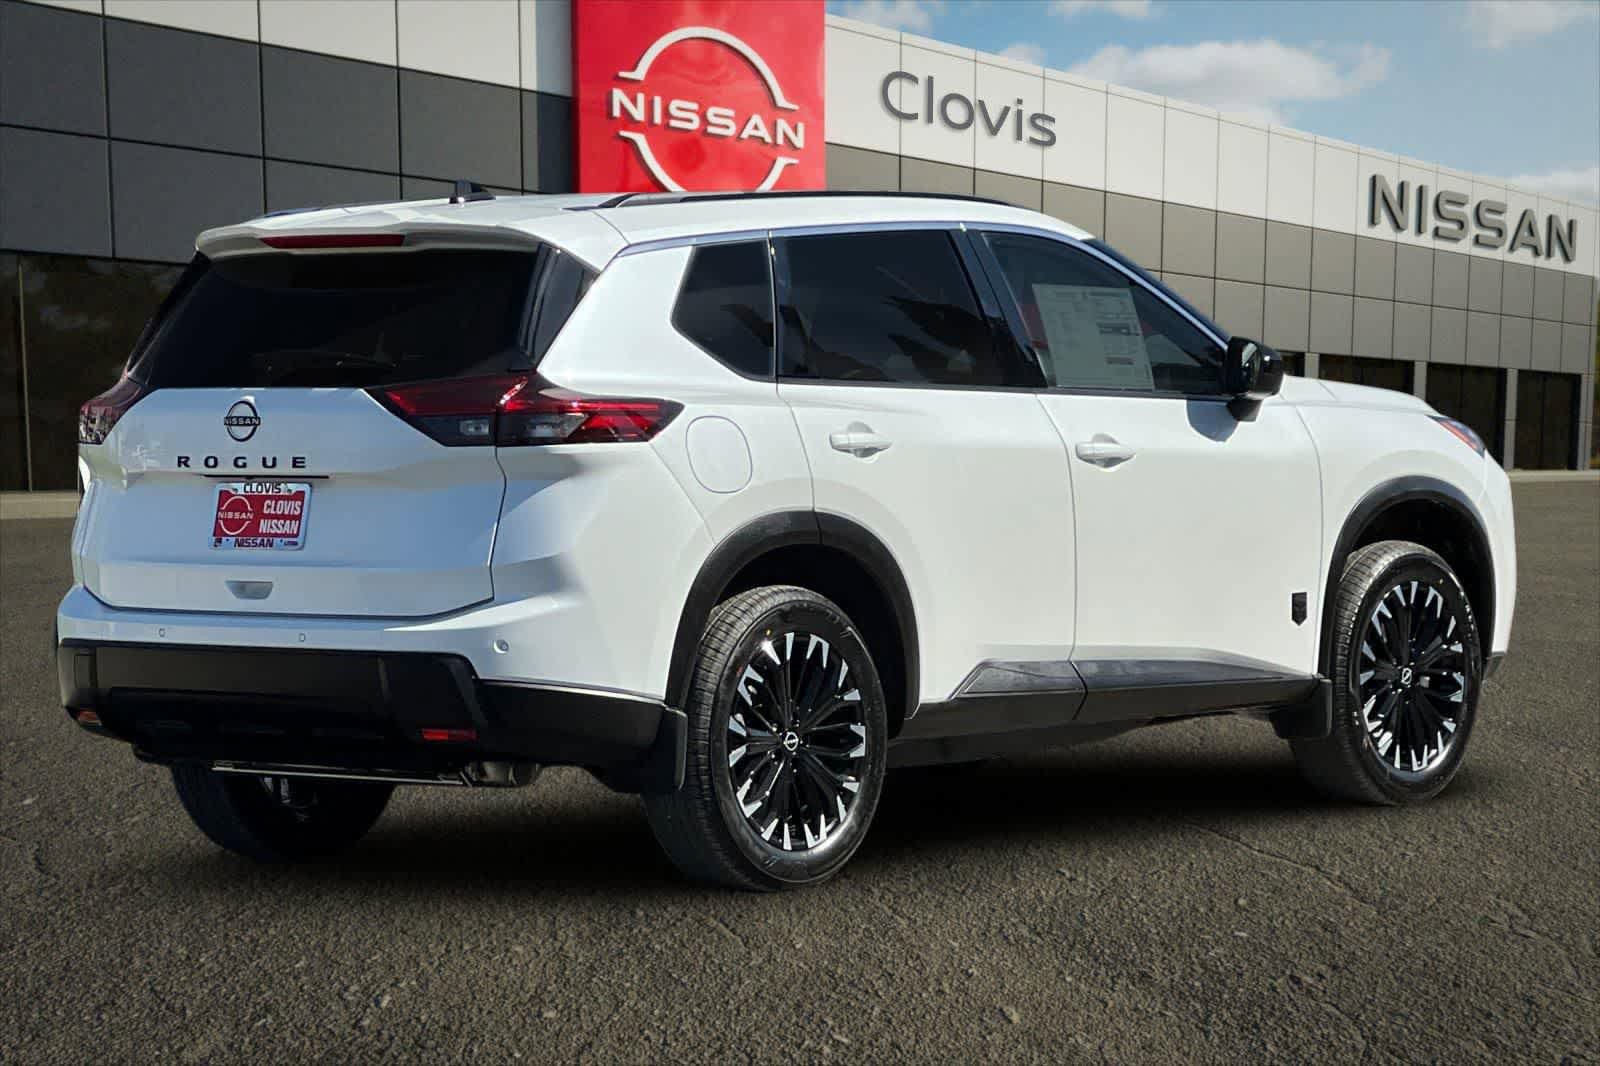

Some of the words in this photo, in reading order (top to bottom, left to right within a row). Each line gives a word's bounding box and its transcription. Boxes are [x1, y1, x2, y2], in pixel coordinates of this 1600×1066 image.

[881, 71, 1057, 147] Clovis
[611, 87, 805, 149] NISSAN
[1368, 174, 1578, 264] NISSAN
[224, 416, 261, 426] NISSAN
[177, 455, 306, 469] ROGUE
[243, 482, 281, 494] CLOVIS
[263, 500, 302, 515] CLOVIS
[217, 511, 254, 520] NISSAN
[258, 519, 299, 534] NISSAN
[233, 538, 274, 548] NISSAN
